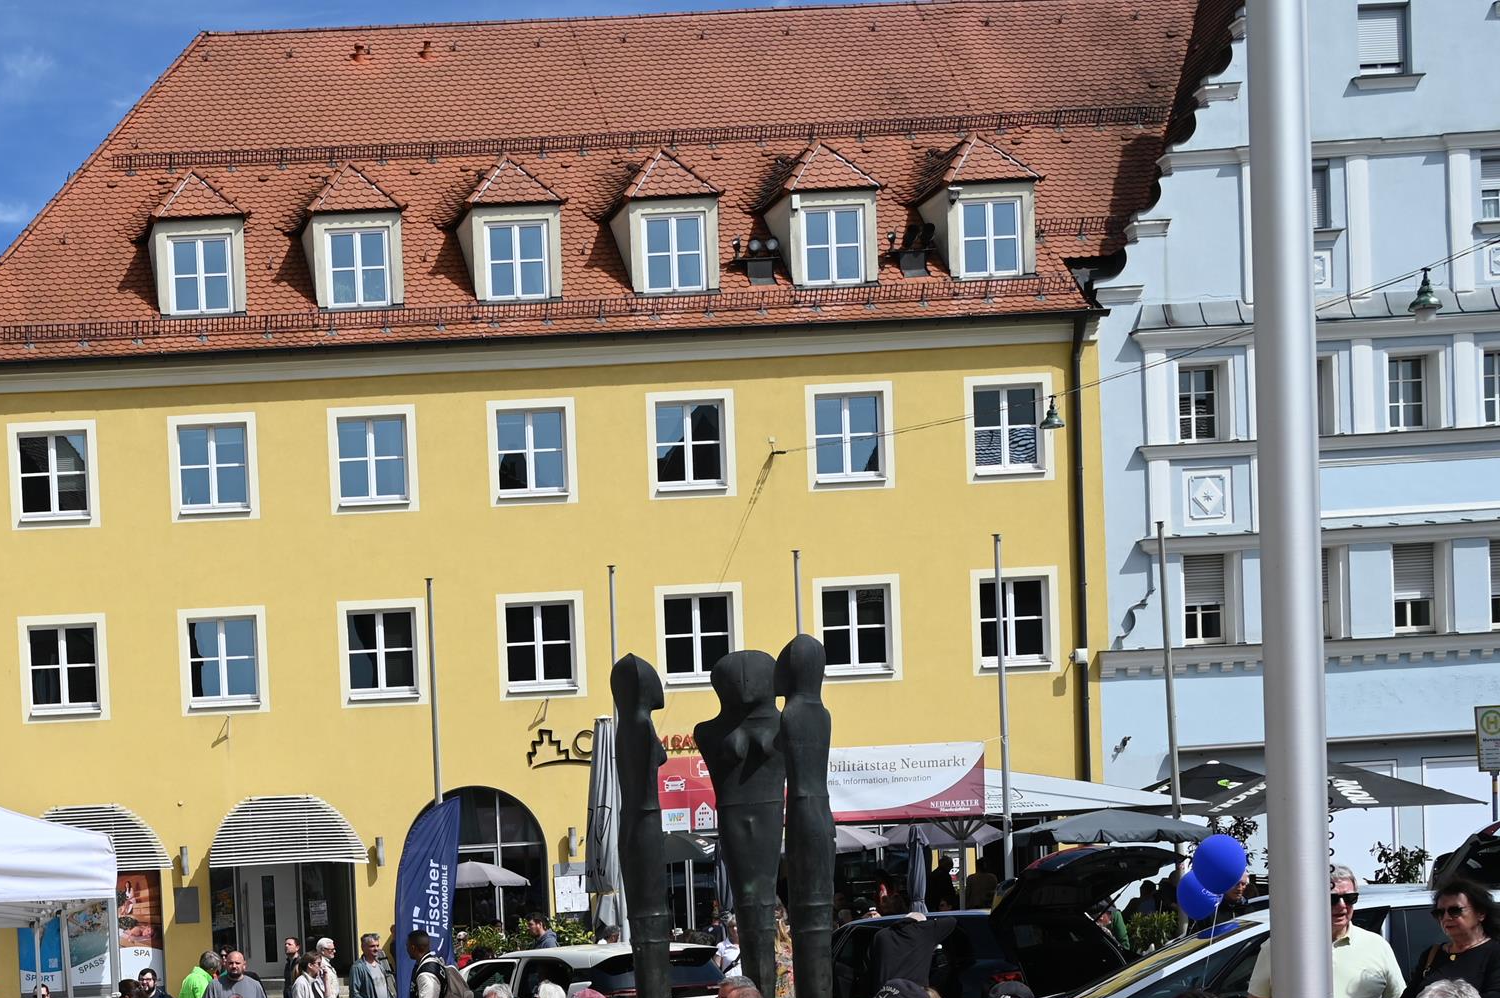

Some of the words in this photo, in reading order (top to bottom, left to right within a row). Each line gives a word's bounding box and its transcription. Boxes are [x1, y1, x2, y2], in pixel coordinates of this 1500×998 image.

[829, 760, 897, 773] bilitätstag
[900, 755, 967, 770] Neumarkt
[843, 776, 890, 785] Information,
[892, 775, 932, 783] Innovation
[930, 799, 980, 809] NEUMARKTER
[426, 859, 440, 938] Fischer
[441, 864, 449, 930] AUTOMOBILE
[133, 949, 150, 957] SPA
[78, 957, 105, 974] SPASS
